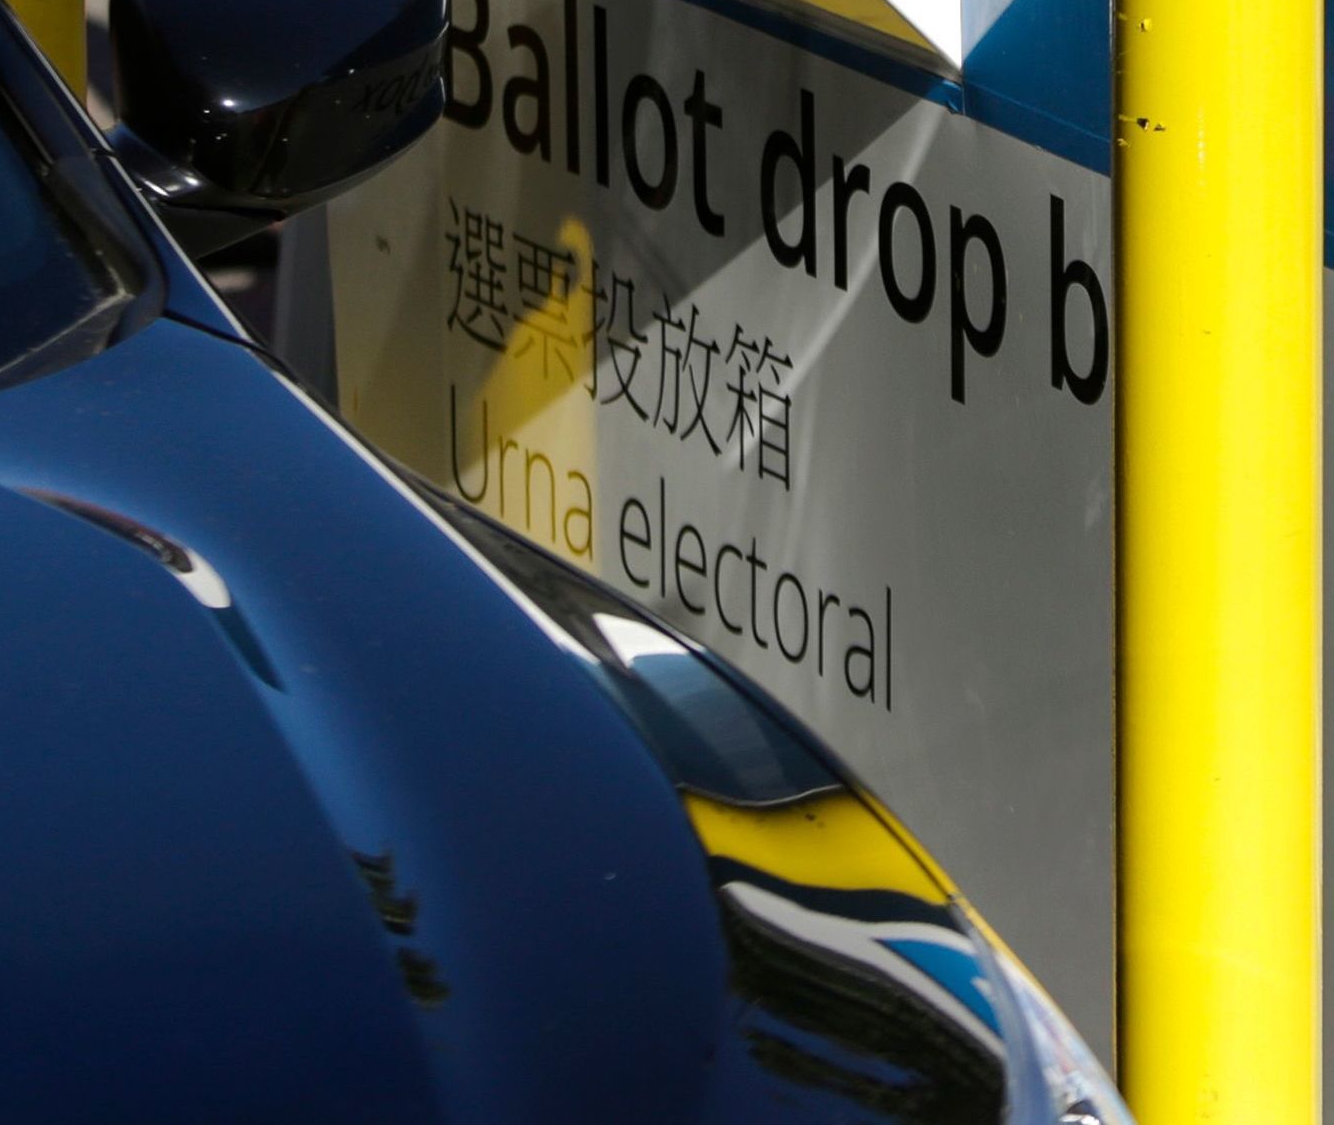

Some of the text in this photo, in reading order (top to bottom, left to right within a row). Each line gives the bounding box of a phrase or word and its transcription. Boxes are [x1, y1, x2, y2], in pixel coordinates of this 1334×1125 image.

[445, 195, 794, 492] 選票投放箱
[761, 88, 1007, 405] drop
[451, 384, 892, 713] Urna electoral
